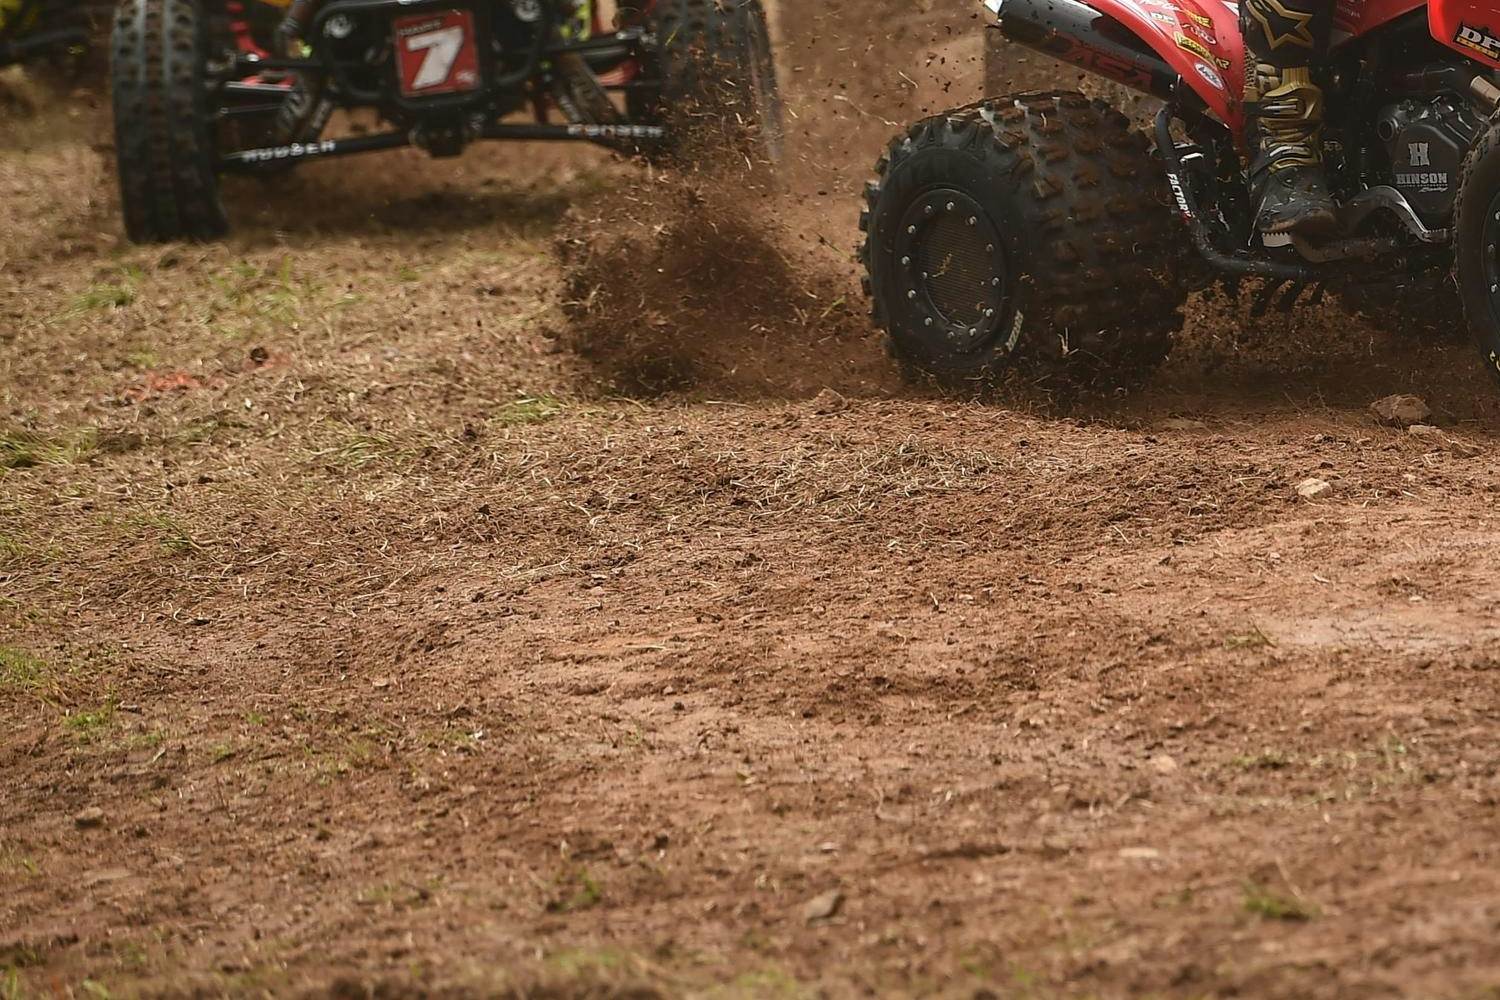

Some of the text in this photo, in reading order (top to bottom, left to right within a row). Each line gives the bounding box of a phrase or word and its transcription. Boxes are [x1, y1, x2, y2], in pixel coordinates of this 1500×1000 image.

[407, 25, 463, 90] 7
[1408, 142, 1430, 167] H
[1396, 172, 1447, 185] HINSON
